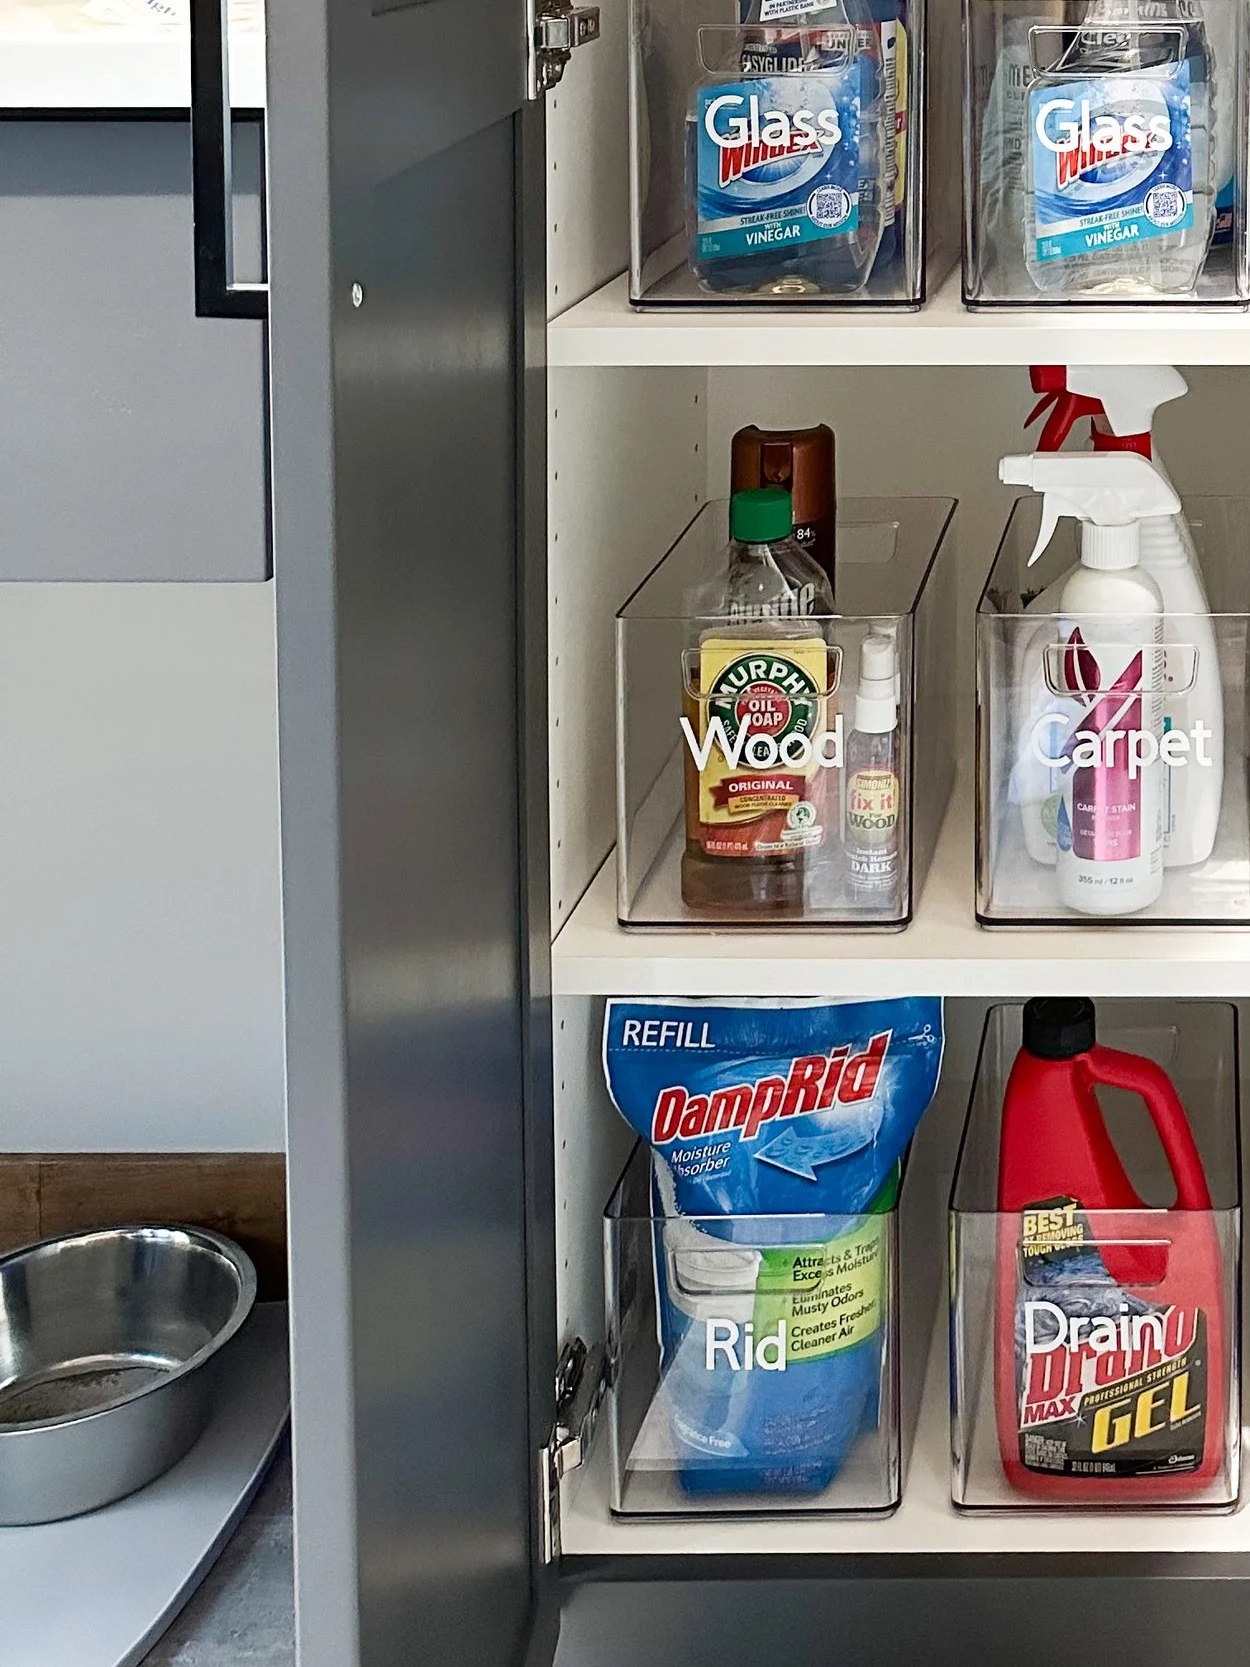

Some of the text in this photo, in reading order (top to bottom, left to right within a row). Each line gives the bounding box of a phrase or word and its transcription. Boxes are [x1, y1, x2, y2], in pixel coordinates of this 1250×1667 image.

[704, 94, 842, 149] Glass
[1035, 98, 1174, 153] Glass
[739, 211, 783, 226] STREAK-FREE
[764, 221, 782, 231] WITH
[1079, 212, 1120, 227] STREAK-FREE
[1103, 220, 1120, 230] WITH
[745, 225, 801, 246] VINEGAR
[1085, 224, 1140, 248] VINEGAR
[715, 660, 813, 710] MURPHY
[749, 699, 777, 713] OIL
[679, 713, 844, 771] Wood
[1031, 712, 1213, 780] Carpet
[728, 780, 794, 793] ORIGINAL
[850, 790, 873, 811] fix
[1111, 803, 1136, 812] STAIN
[848, 811, 896, 830] WOOD
[851, 860, 893, 873] DARK
[1078, 875, 1118, 884] 355 12
[622, 1019, 716, 1049] REFILL
[652, 1029, 893, 1145] DampRid
[671, 1140, 732, 1164] Moisture
[1023, 1202, 1077, 1237] BEST
[792, 1249, 852, 1269] Attracts &
[792, 1265, 834, 1282] Excess
[791, 1288, 864, 1318] Musty Odors
[791, 1299, 876, 1338] Creates Fresher
[1024, 1300, 1163, 1354] Drain
[705, 1318, 787, 1371] Rid
[791, 1323, 855, 1352] Cleaner Air
[1083, 1357, 1188, 1405] PROFESSIONAL STRENGTH
[1023, 1396, 1077, 1424] MAX
[1091, 1371, 1201, 1454] GEL
[708, 1435, 732, 1449] Free
